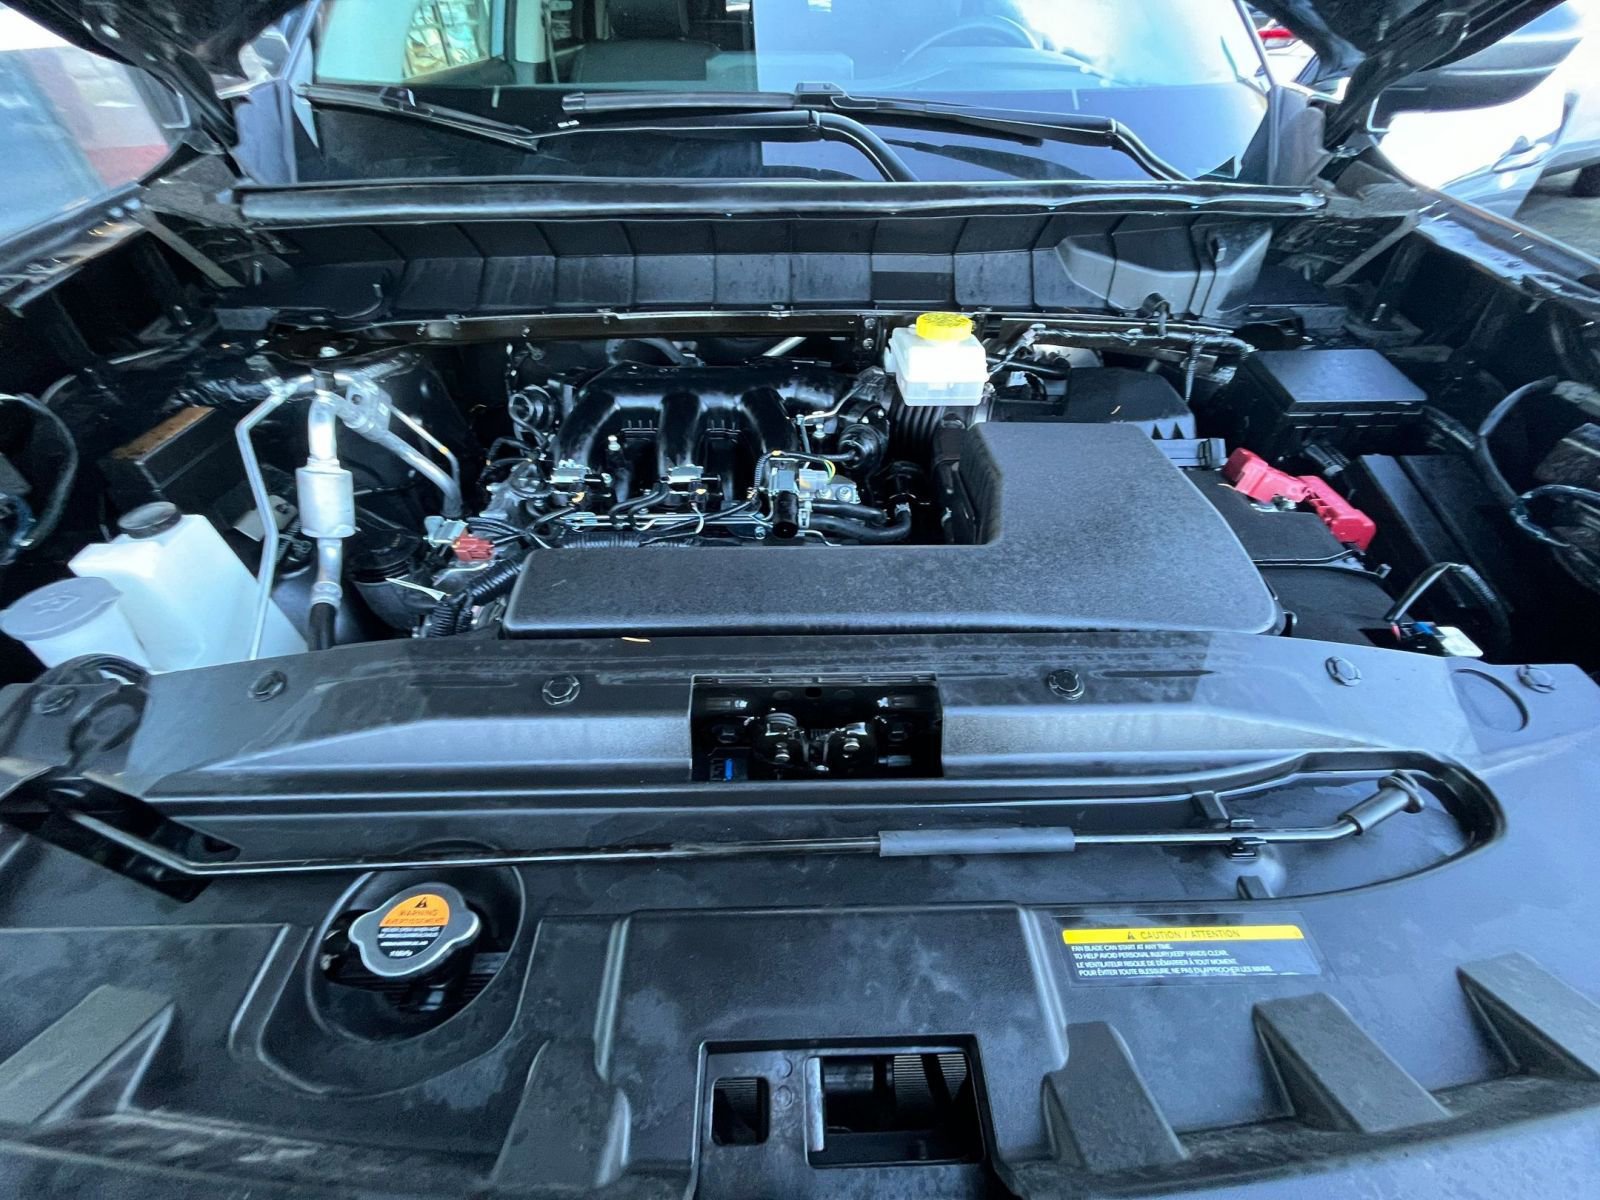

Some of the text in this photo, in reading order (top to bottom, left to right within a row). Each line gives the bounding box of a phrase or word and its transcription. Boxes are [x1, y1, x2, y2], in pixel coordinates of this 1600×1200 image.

[1191, 929, 1241, 939] ATTENTION
[1118, 951, 1150, 959] PERSONAL
[1079, 969, 1097, 977] POUR
[1118, 968, 1138, 976] TOUTE
